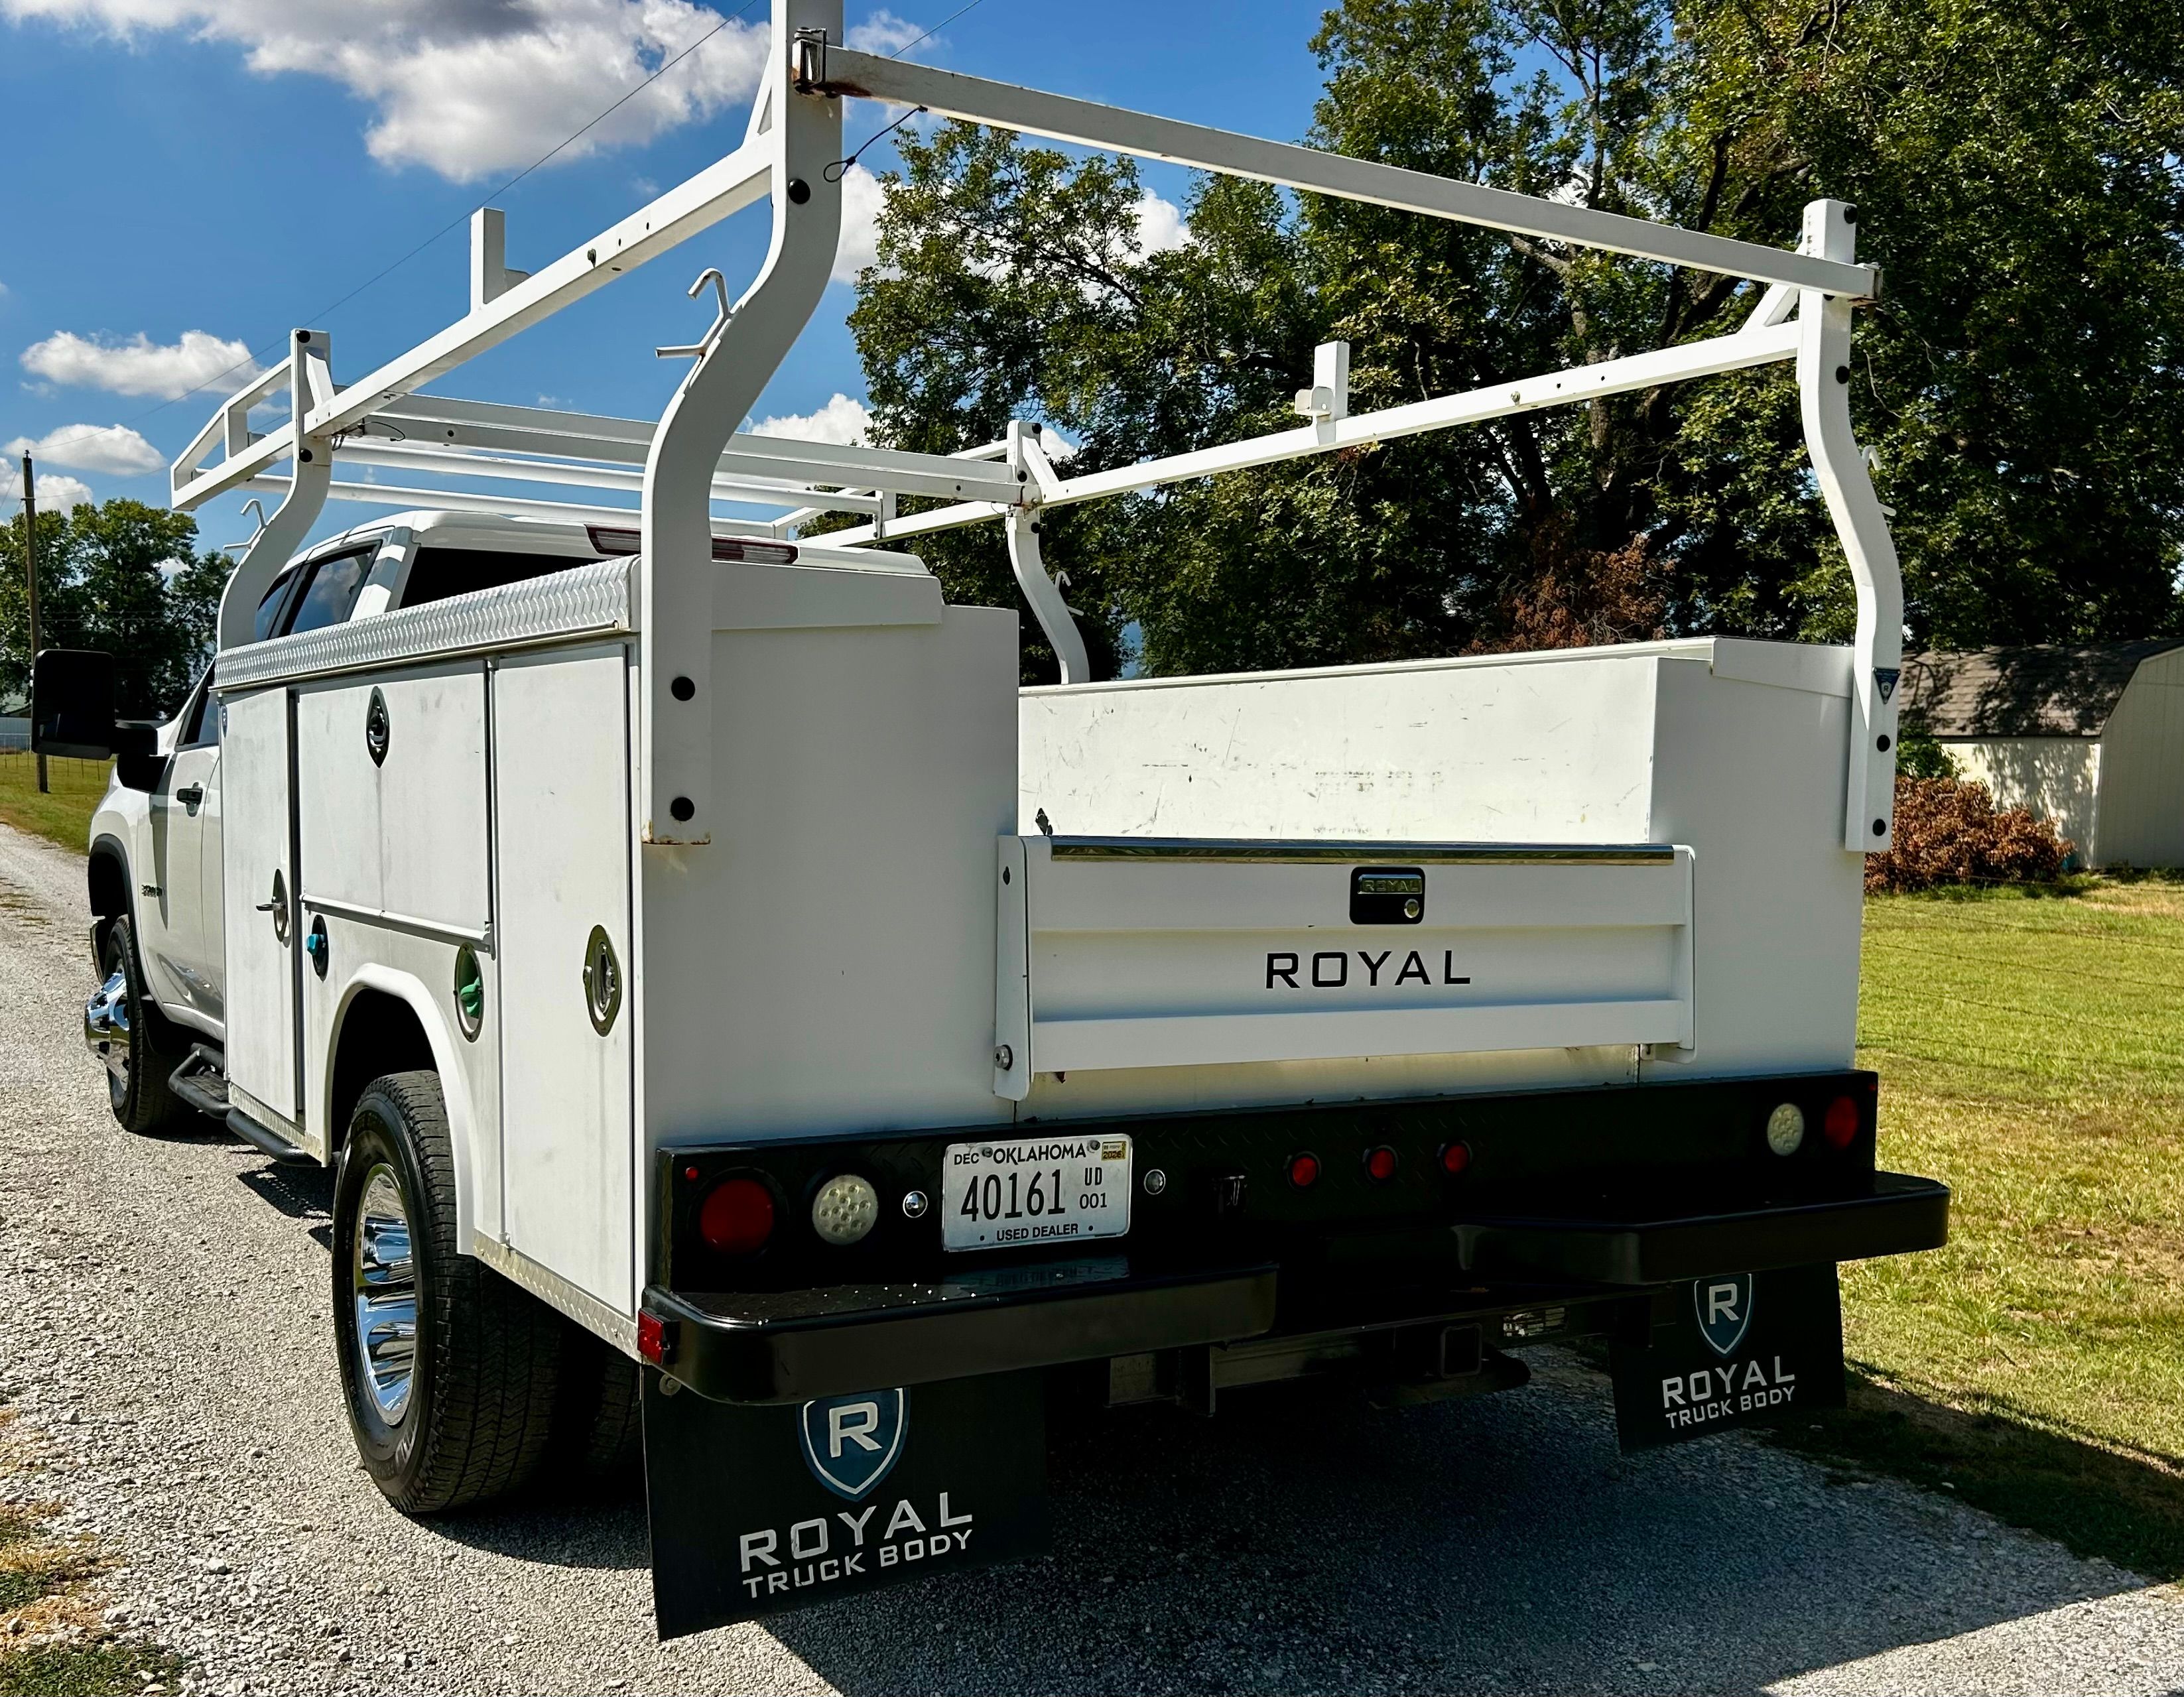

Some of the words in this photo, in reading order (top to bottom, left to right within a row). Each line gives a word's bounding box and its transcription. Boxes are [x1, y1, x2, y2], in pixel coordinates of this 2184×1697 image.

[1362, 879, 1419, 892] ROYAL
[1265, 950, 1470, 989] ROYAL
[954, 1153, 980, 1165] DEC
[995, 1143, 1086, 1165] OKLAHOMA
[960, 1169, 1065, 1222] 40161
[1084, 1167, 1102, 1186] UD
[1079, 1192, 1107, 1210] 001
[996, 1227, 1029, 1241] USED
[1032, 1224, 1078, 1238] DEALER
[1708, 1283, 1740, 1324] R
[1662, 1355, 1795, 1409] ROYAL
[1665, 1399, 1734, 1428] TRUCK
[1740, 1385, 1795, 1411] BODY
[828, 1401, 882, 1458] R
[739, 1492, 972, 1572] ROYAL
[742, 1552, 866, 1598] TRUCK
[879, 1529, 972, 1567] BODY
